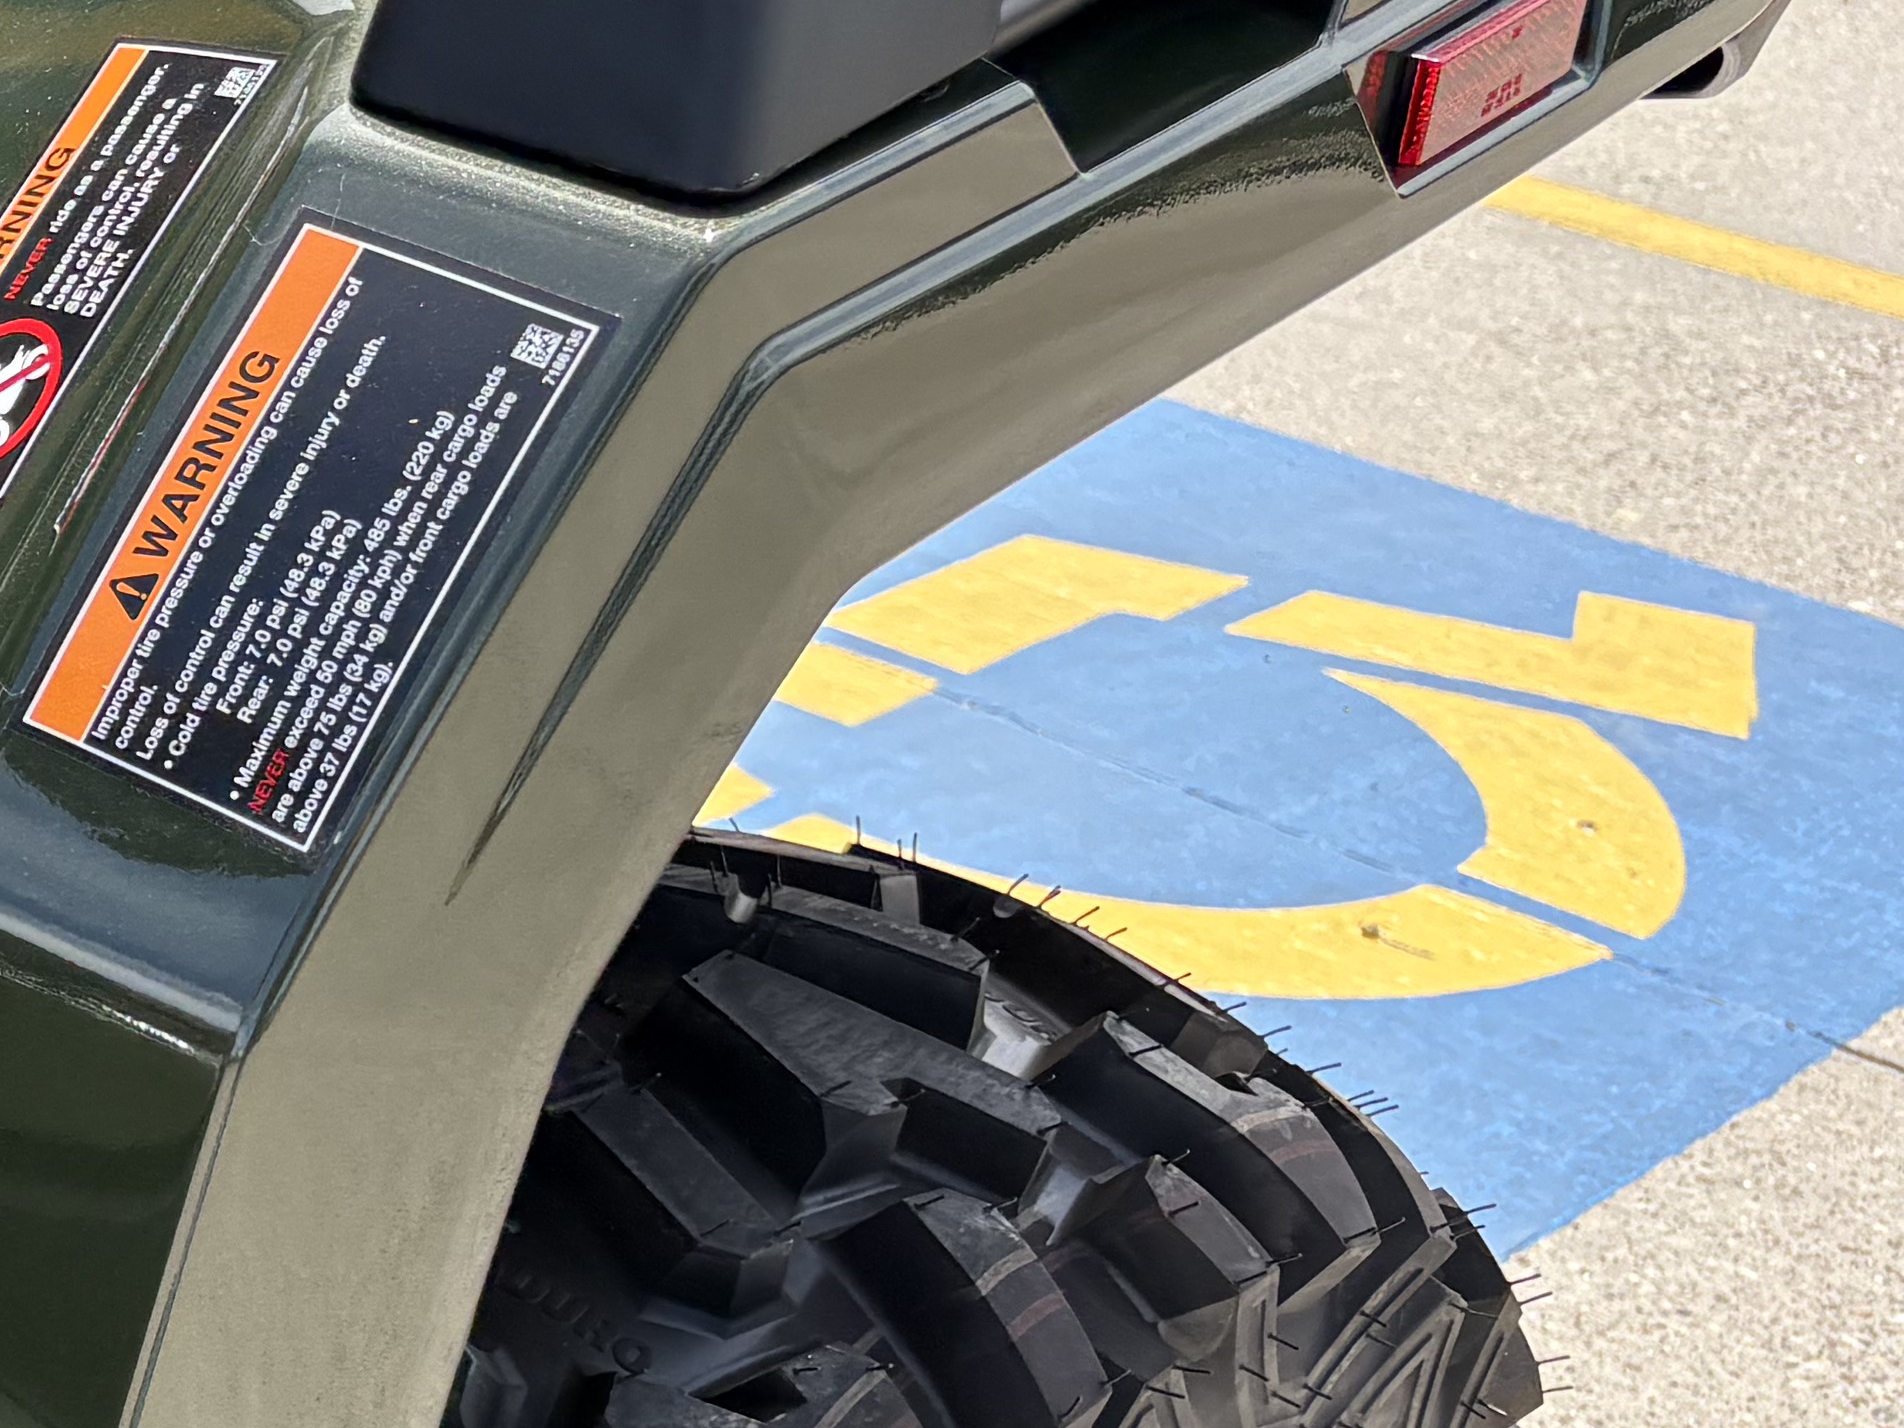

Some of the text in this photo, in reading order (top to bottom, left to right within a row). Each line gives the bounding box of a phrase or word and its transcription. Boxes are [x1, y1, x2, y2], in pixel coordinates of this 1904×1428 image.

[91, 275, 363, 739] Improper tire pressure or overloading can cause loss of
[132, 351, 279, 556] WARNING
[135, 335, 385, 759] Loss of control can result in severe injury or death.
[168, 598, 263, 755] Cold tire pressure:
[215, 510, 340, 714] Front: 7.0 psi (48.3 kPa)
[233, 410, 455, 787] Maximum weight capacity: 485 lbs. (220 kg)
[236, 518, 362, 723] Rear: 7.0 psi (48.3 kPa)
[247, 365, 506, 814] NEVER exceed 50 mph (80 kph) when rear cargo loads
[271, 391, 517, 822] are above 75 lbs (34 kg) and/or front cargo loads are
[115, 685, 157, 748] control.
[293, 661, 393, 832] above 37 lbs (17 kg).
